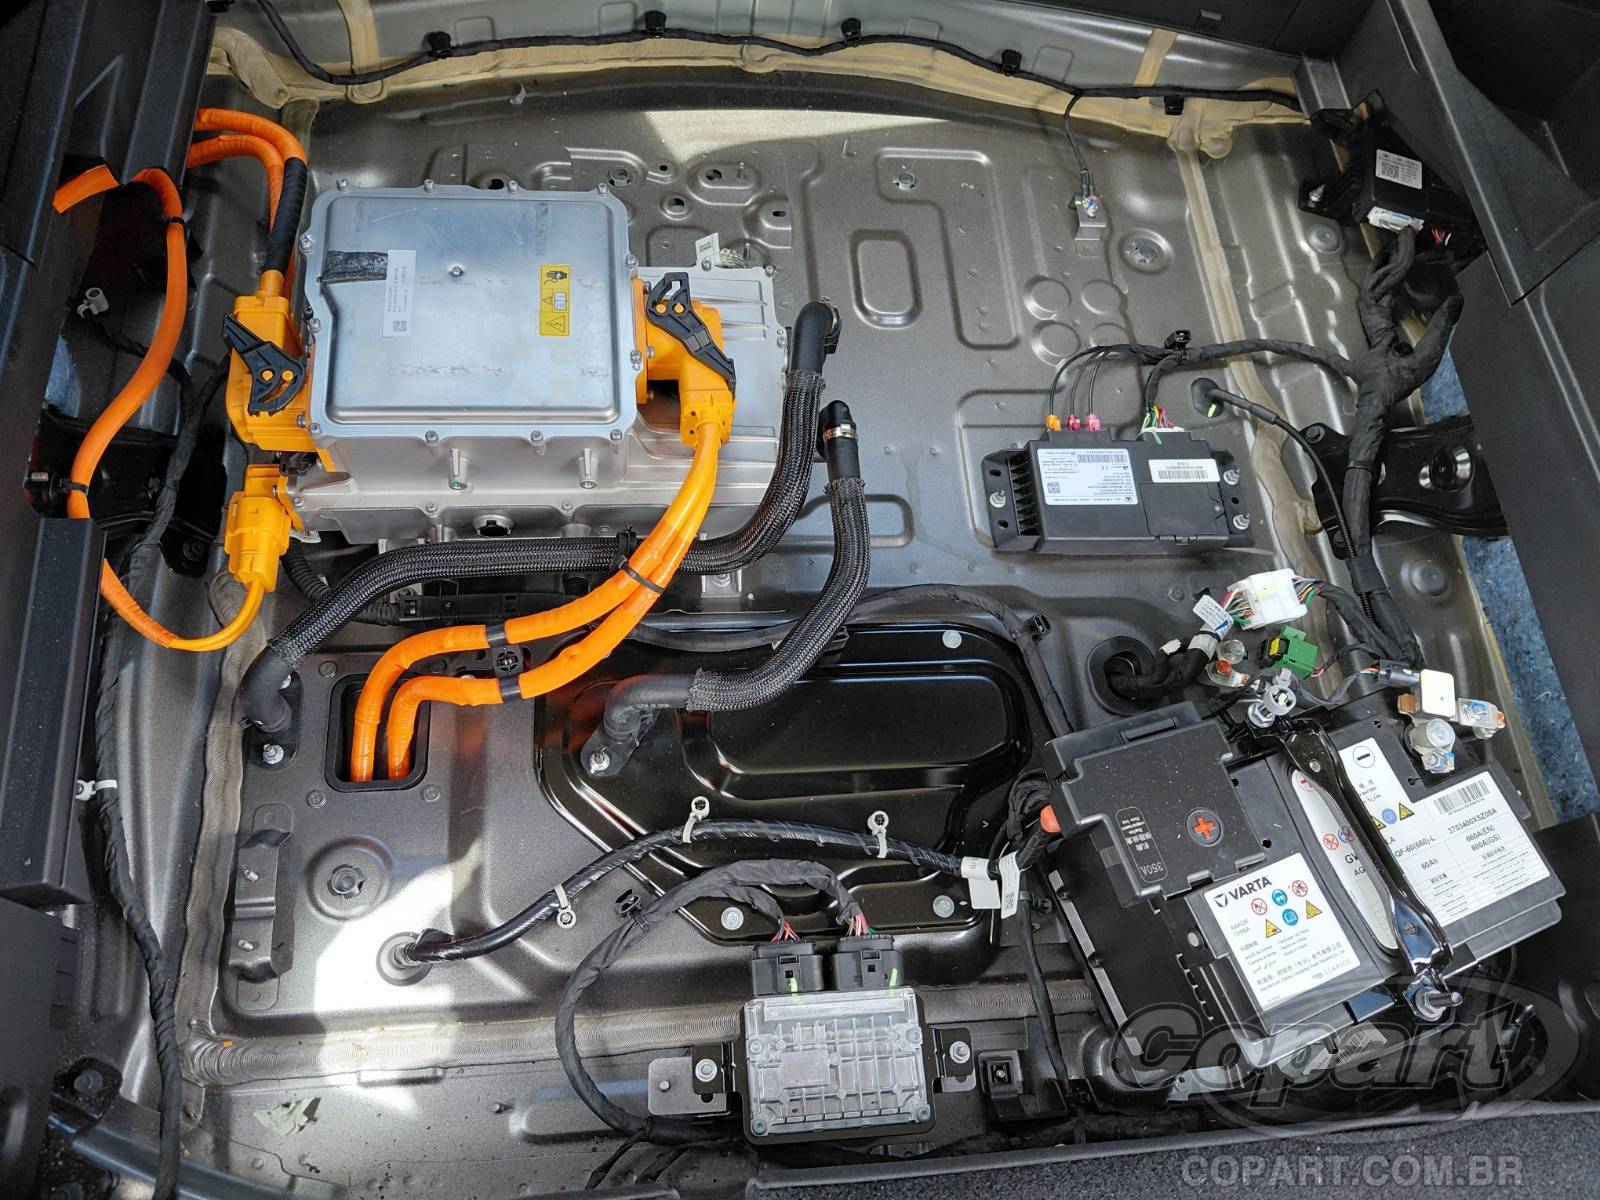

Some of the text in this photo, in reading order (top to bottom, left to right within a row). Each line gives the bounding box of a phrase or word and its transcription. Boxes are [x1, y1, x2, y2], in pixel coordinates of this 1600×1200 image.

[1470, 833, 1502, 851] 600A(GS)
[1139, 861, 1164, 876] 350A
[1228, 876, 1273, 901] VARTA
